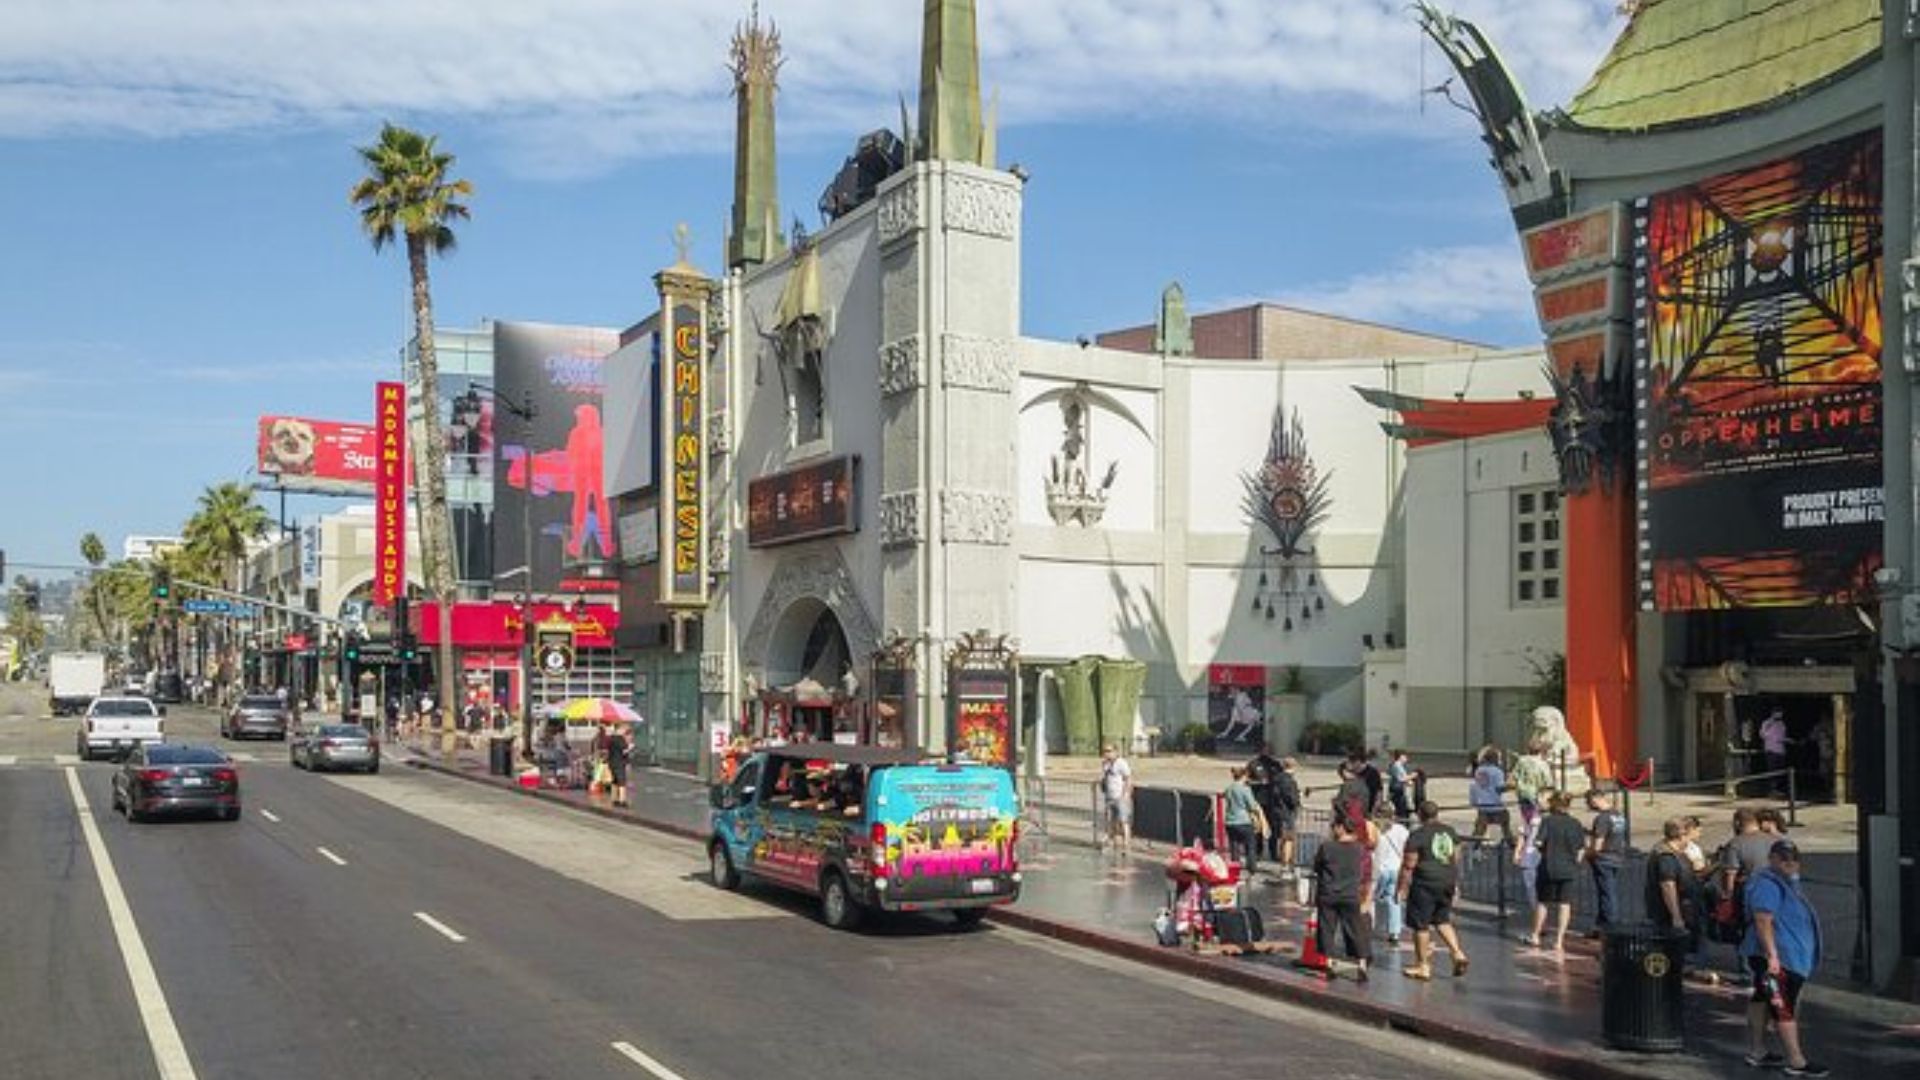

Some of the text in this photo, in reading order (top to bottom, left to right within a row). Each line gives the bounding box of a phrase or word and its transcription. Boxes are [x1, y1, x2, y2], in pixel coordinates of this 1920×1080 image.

[1658, 404, 1875, 449] OPPENHEIME
[675, 325, 699, 574] CHINESE
[383, 387, 399, 601] MADAME TUSSAUDS
[1784, 491, 1837, 511] PROUDLY
[1784, 513, 1797, 528] IN
[1799, 510, 1827, 526] IMAX
[714, 731, 726, 747] 3
